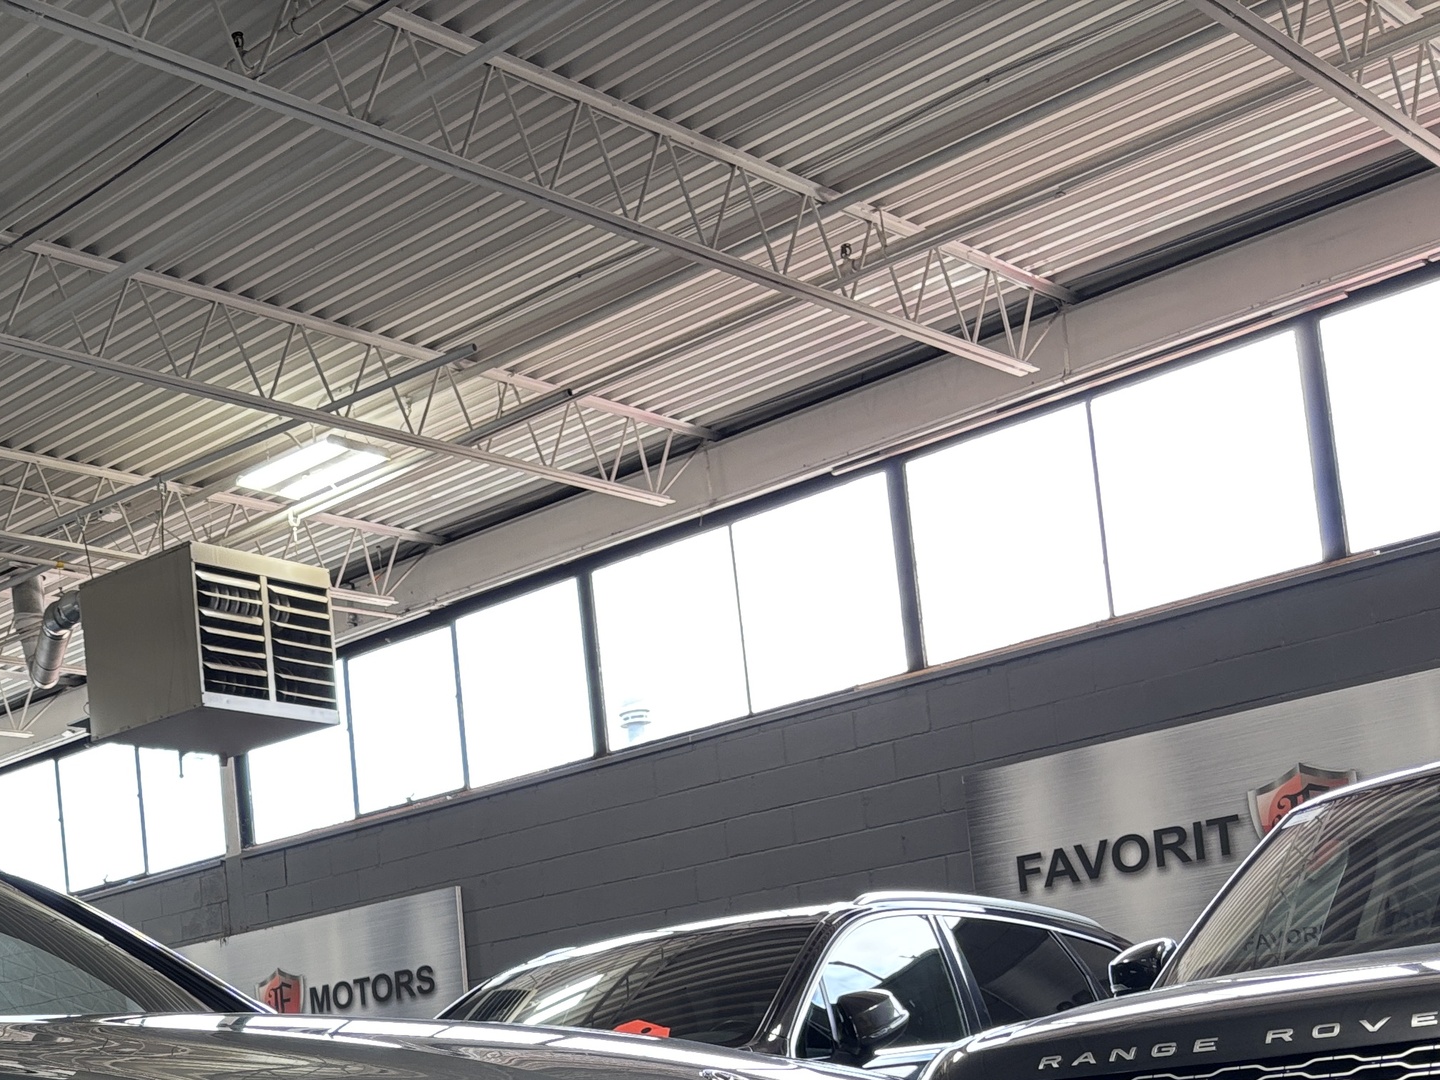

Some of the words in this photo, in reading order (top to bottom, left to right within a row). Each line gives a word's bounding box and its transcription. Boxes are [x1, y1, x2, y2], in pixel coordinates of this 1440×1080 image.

[1016, 813, 1240, 893] FAVORIT
[309, 964, 436, 1014] MOTORS
[1037, 1036, 1220, 1071] RANGE
